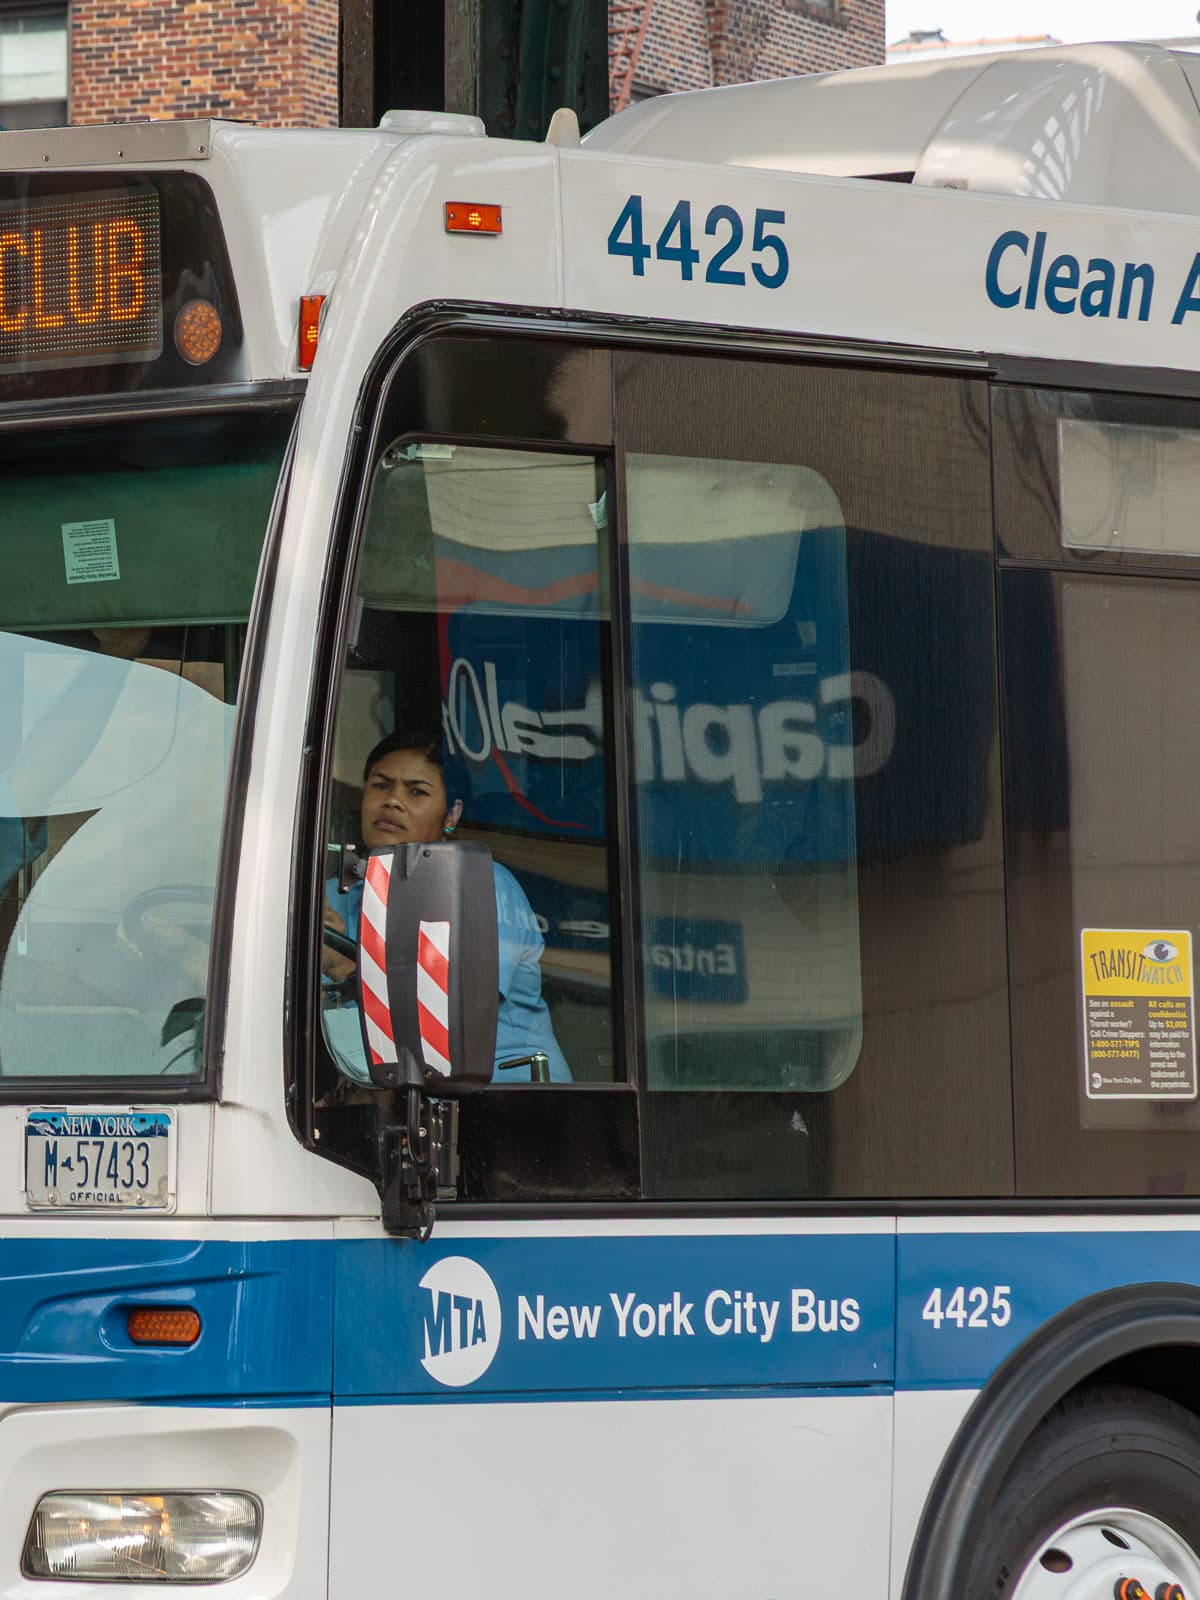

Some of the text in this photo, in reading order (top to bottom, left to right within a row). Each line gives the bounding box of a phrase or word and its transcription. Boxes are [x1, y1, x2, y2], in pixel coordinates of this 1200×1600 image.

[607, 194, 790, 289] 4425
[985, 230, 1155, 322] Clean
[1090, 948, 1184, 986] TRANSIT WATCH
[60, 1116, 137, 1137] NEW YORK
[70, 1192, 123, 1203] OFFICIAL
[421, 1286, 487, 1359] MTA
[517, 1288, 860, 1343] New York City Bus
[922, 1285, 1012, 1329] 4425
